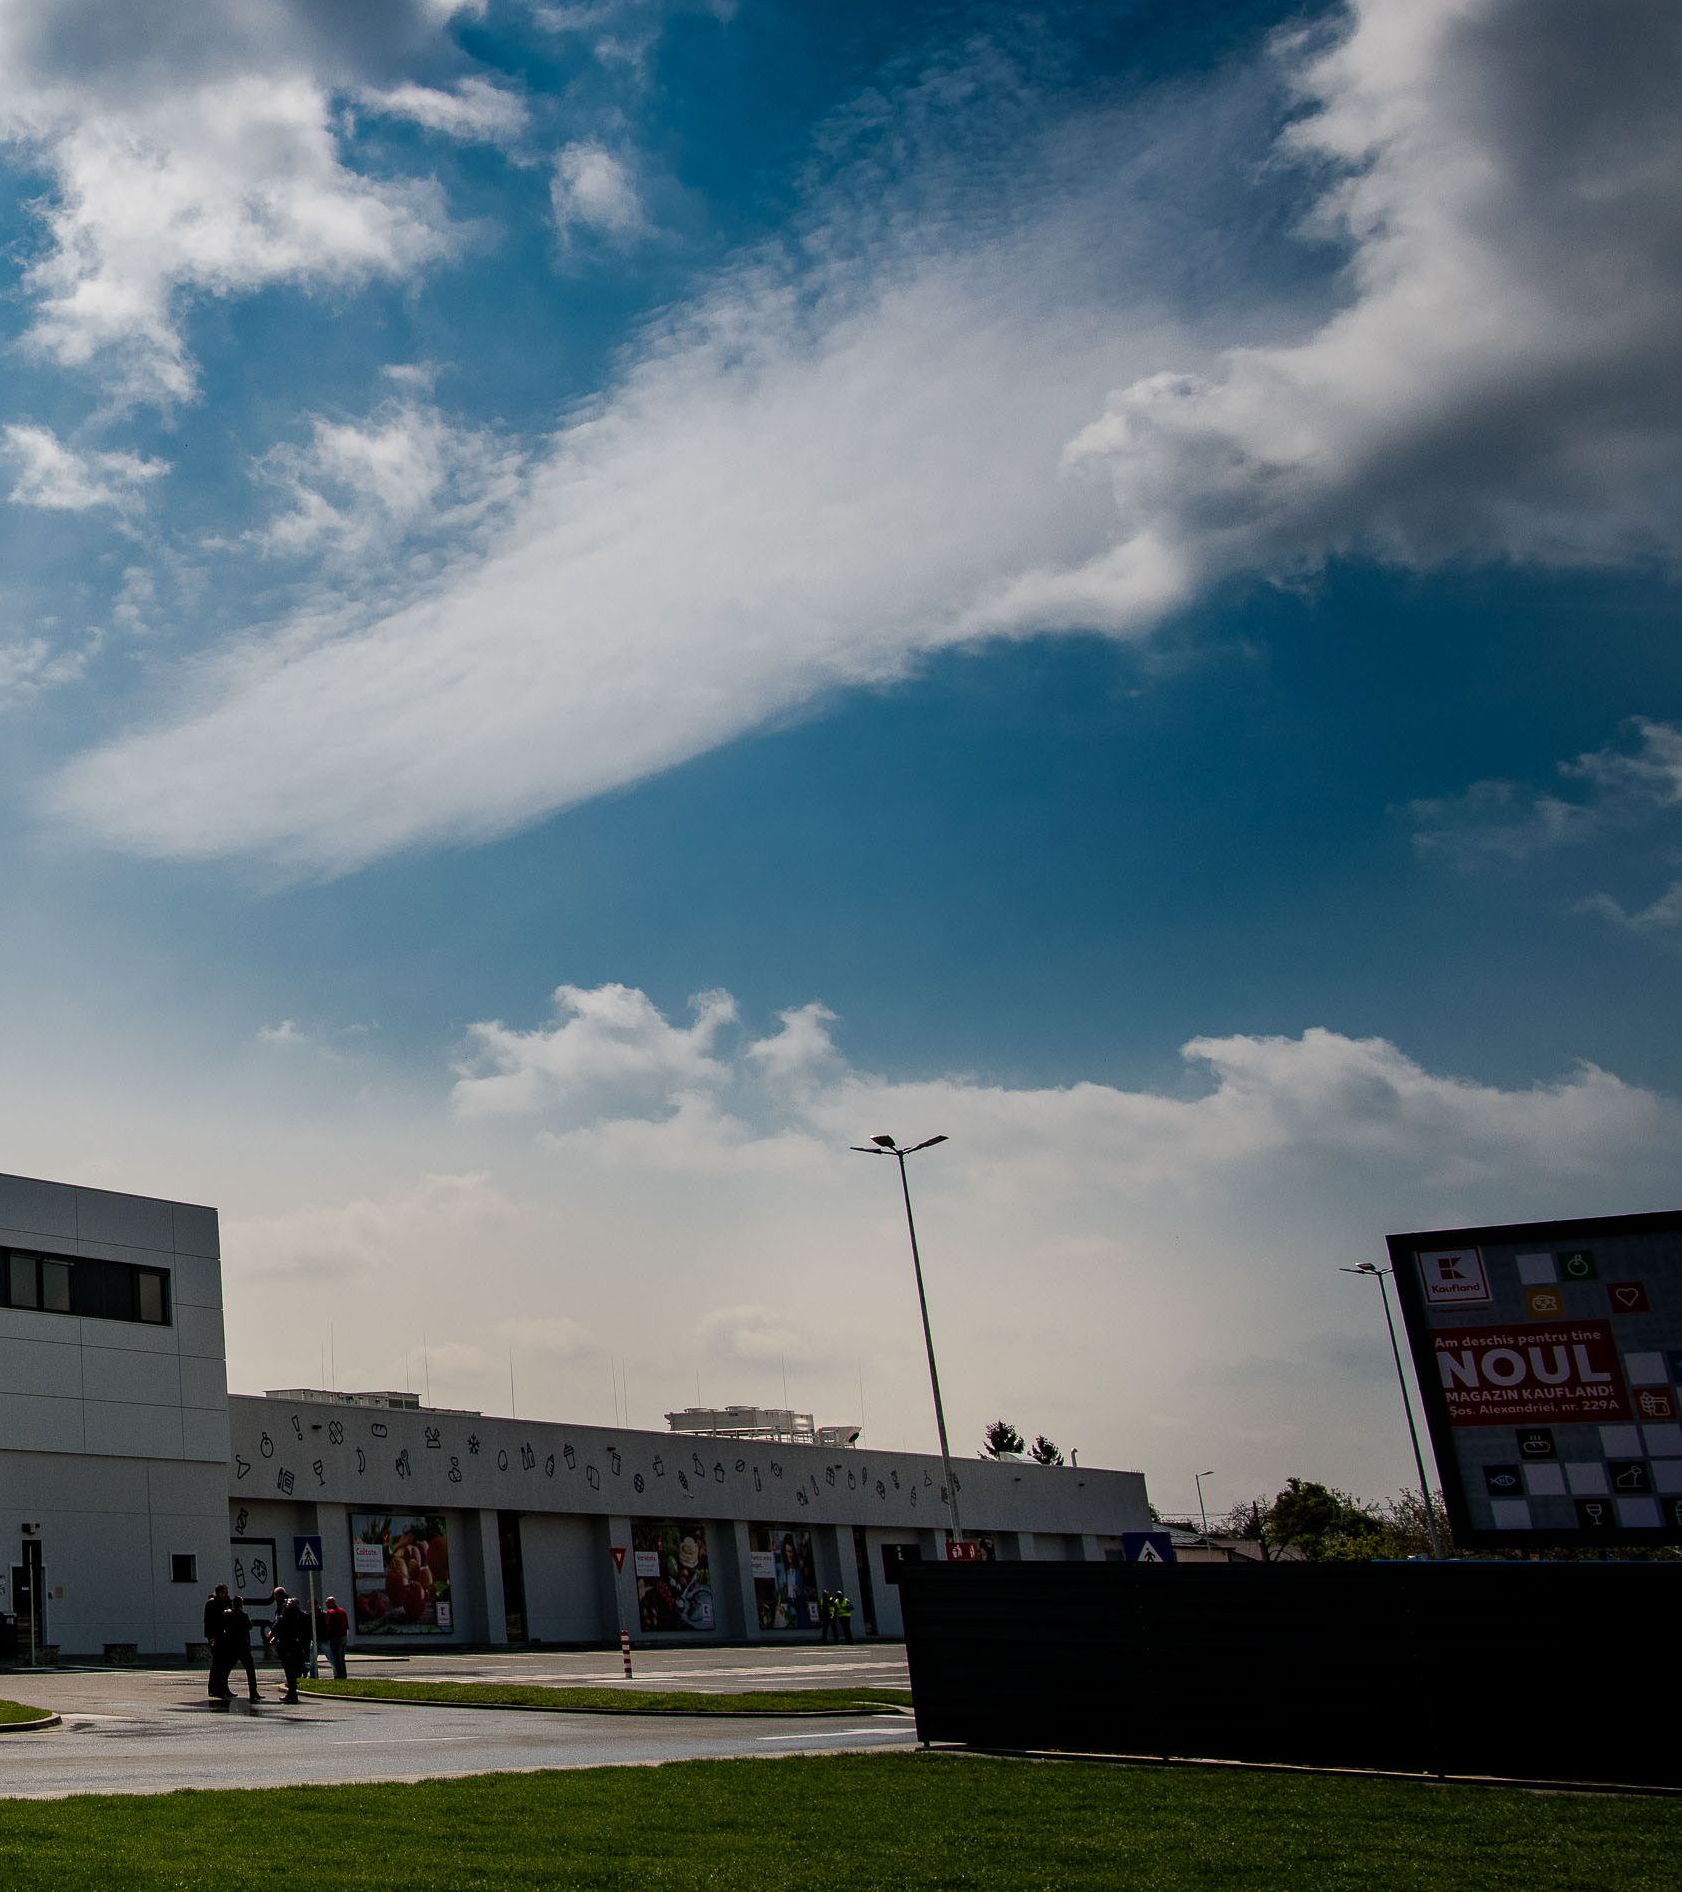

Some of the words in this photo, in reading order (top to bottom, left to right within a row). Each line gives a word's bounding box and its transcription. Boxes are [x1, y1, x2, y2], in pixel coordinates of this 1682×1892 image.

[1432, 1282, 1480, 1294] Kaufland
[1435, 1337, 1458, 1348] Am
[1464, 1333, 1515, 1347] deschis
[1518, 1332, 1567, 1346] pentru
[1571, 1330, 1601, 1341] tine
[1436, 1345, 1612, 1388] NOUL
[1446, 1389, 1518, 1403] MAGAZIN
[1521, 1386, 1614, 1400] KAUFLAND!
